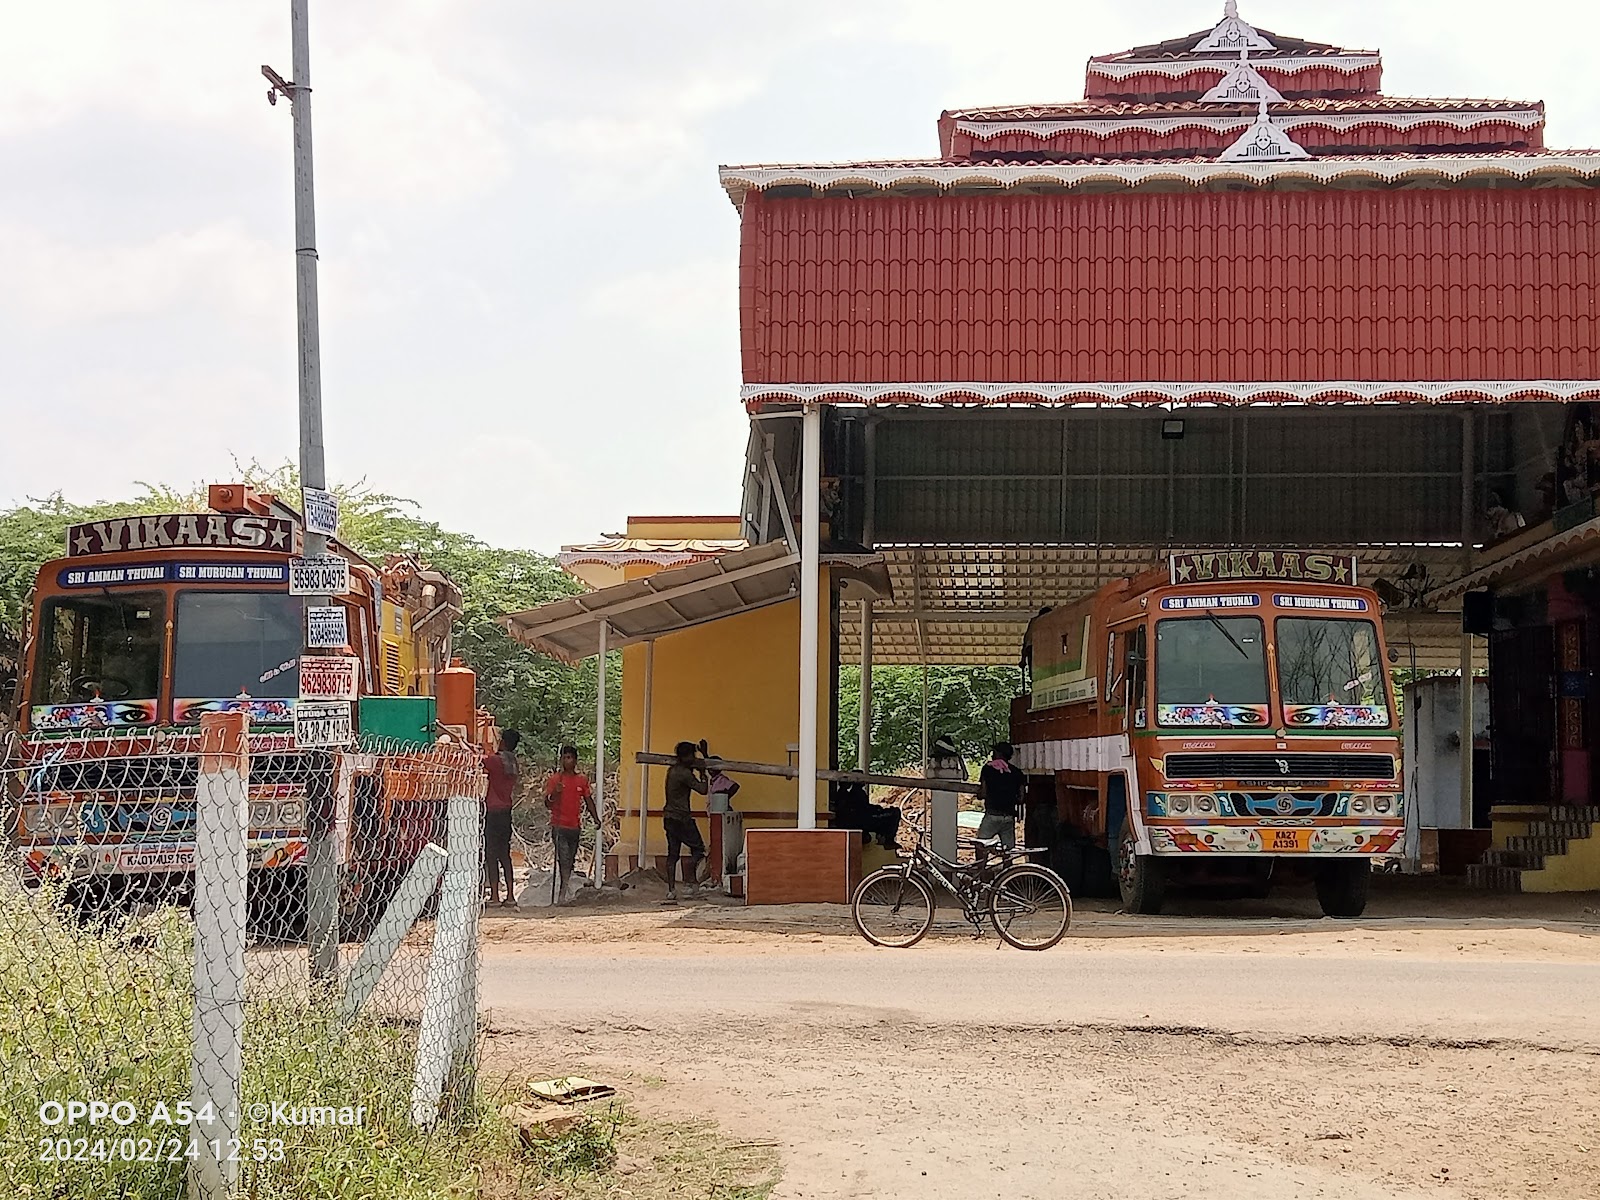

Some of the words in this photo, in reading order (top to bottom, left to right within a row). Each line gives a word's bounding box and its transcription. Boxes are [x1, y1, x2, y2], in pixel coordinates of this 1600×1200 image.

[92, 514, 269, 551] VIKAAS
[1191, 551, 1334, 579] VIKAAS
[67, 571, 85, 584] SRI
[87, 570, 124, 583] AMMAN
[126, 566, 165, 581] THUNAI
[178, 566, 196, 579] SRI
[198, 566, 245, 579] MURUGAN
[246, 566, 284, 579] THUNAI
[293, 569, 320, 589] 96983
[1168, 598, 1185, 608] SRI
[1186, 597, 1219, 608] AMMAN
[1219, 595, 1254, 607] THUNAI
[1279, 596, 1294, 607] SRI
[1294, 596, 1331, 609] MURUGAN
[1275, 831, 1297, 840] KA27
[1272, 839, 1299, 849] A1391
